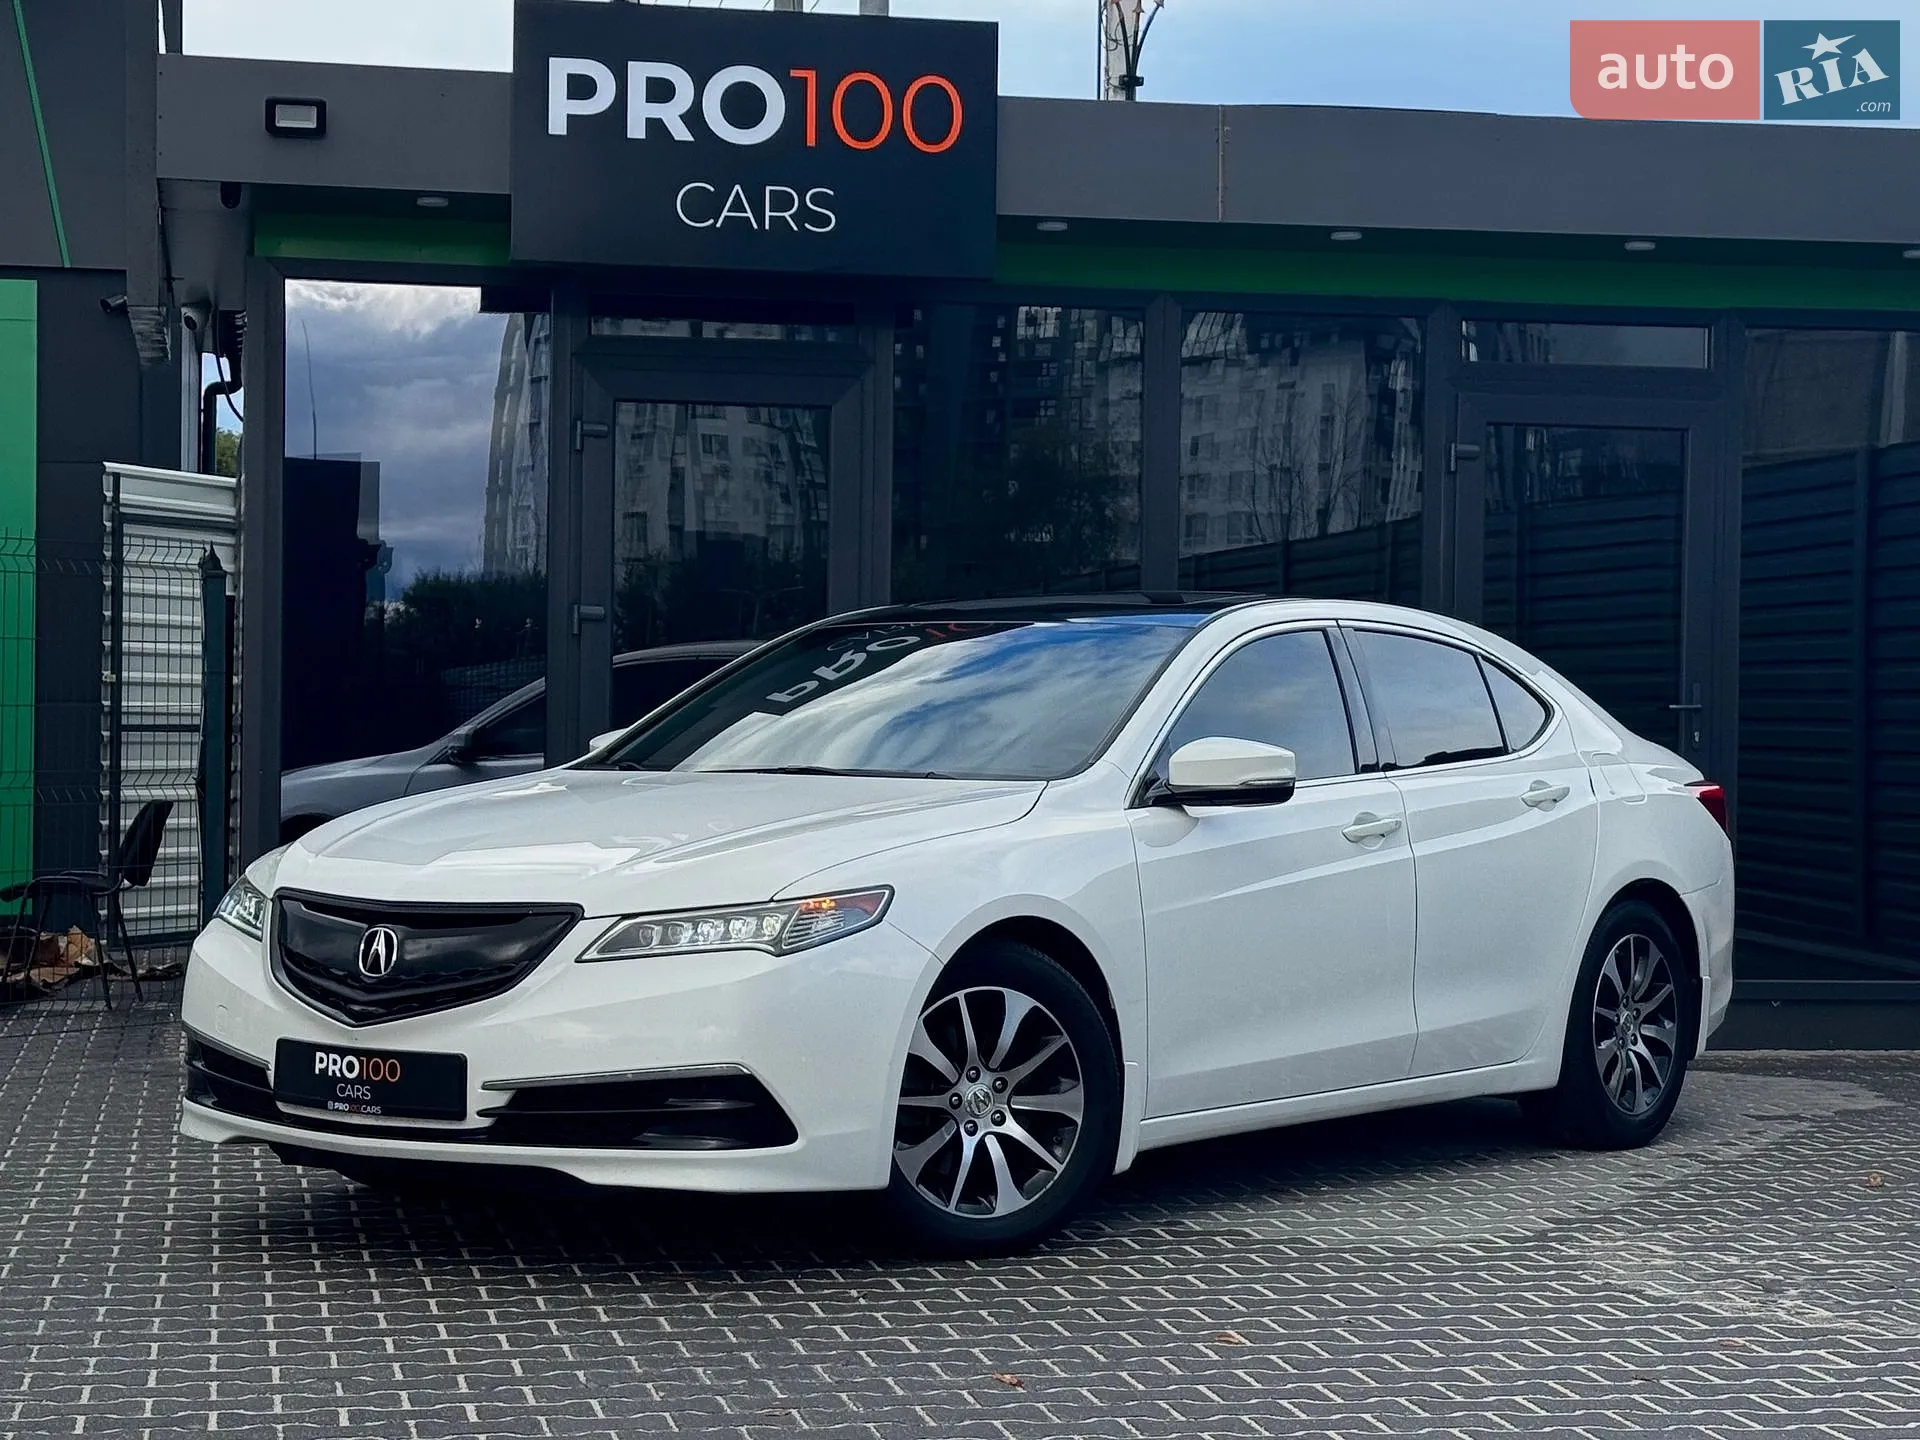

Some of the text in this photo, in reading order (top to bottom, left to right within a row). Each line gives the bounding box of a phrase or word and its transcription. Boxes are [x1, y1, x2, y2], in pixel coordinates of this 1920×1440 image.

[548, 57, 963, 153] PRO100
[676, 182, 836, 232] CARS
[314, 1051, 400, 1082] PRO100
[336, 1083, 371, 1100] CARS
